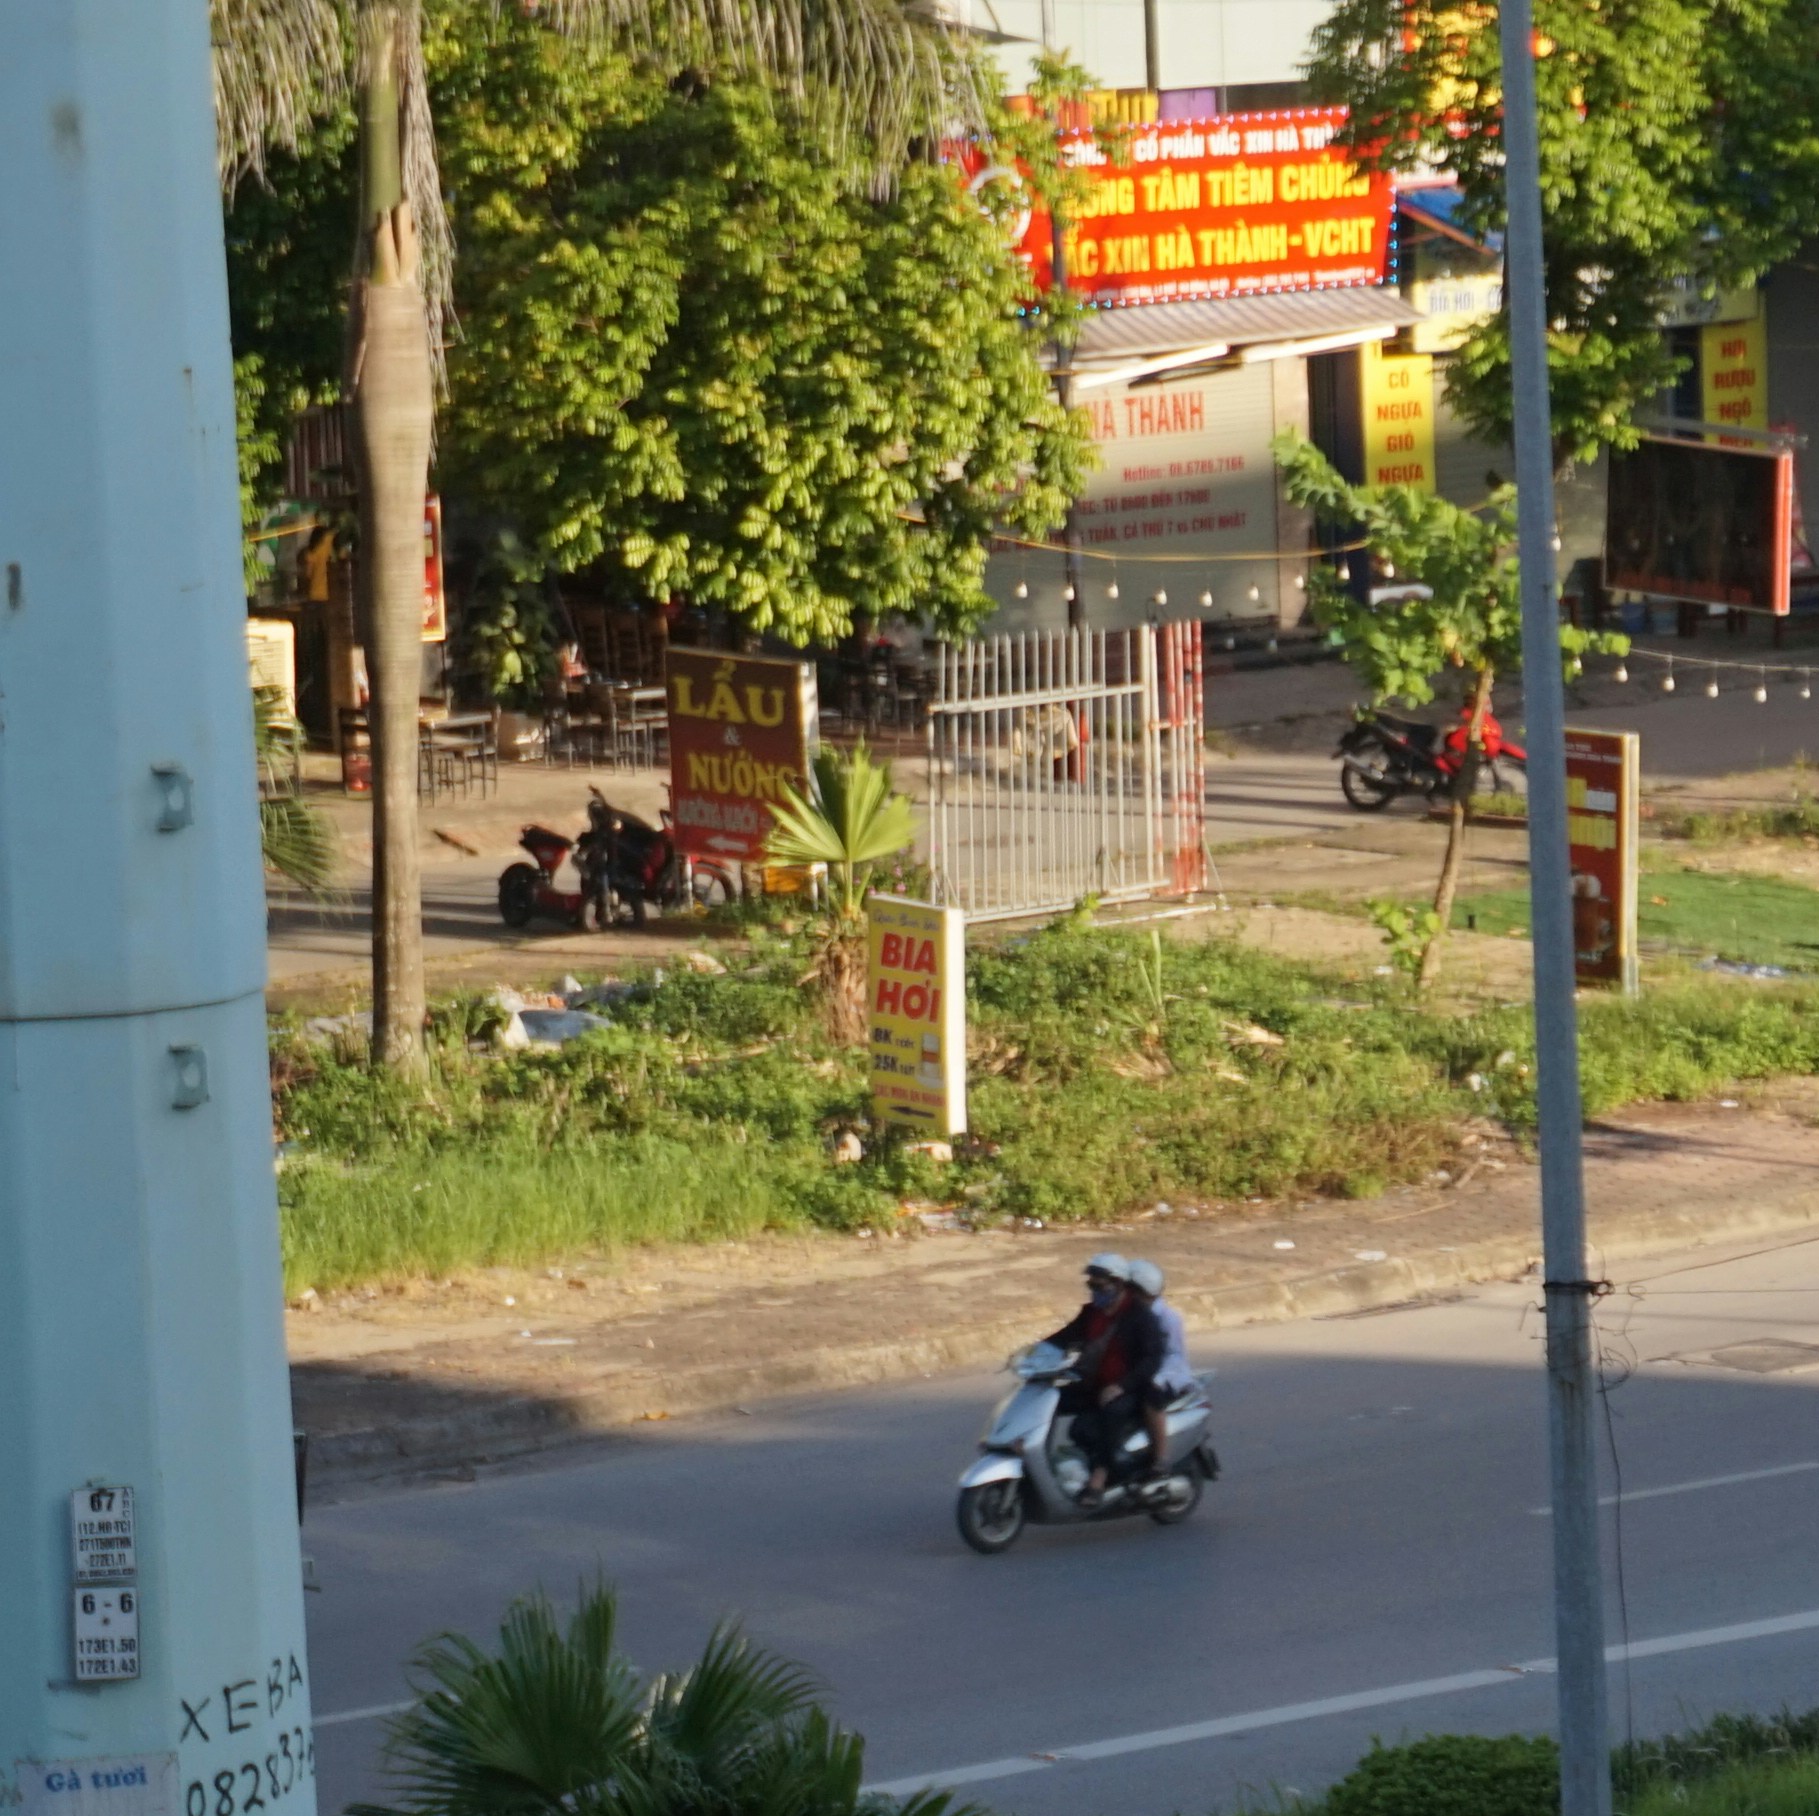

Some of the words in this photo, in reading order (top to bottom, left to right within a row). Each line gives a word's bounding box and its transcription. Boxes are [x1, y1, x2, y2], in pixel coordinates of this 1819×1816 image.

[1207, 123, 1240, 156] VẮC
[1244, 129, 1274, 154] XIN
[1275, 123, 1299, 152] HÀ
[1141, 166, 1200, 212] TÂM
[1205, 160, 1274, 207] TIÊM
[1102, 234, 1150, 274] XIN
[1154, 223, 1196, 270] HÀ
[1124, 381, 1204, 437] THÀNH
[674, 660, 785, 727] LẨU
[880, 931, 938, 977] BIA
[876, 978, 941, 1024] HƠI
[90, 1491, 114, 1512] 67
[82, 1593, 96, 1614] 6
[120, 1592, 133, 1614] 6
[45, 1768, 82, 1793] Gà
